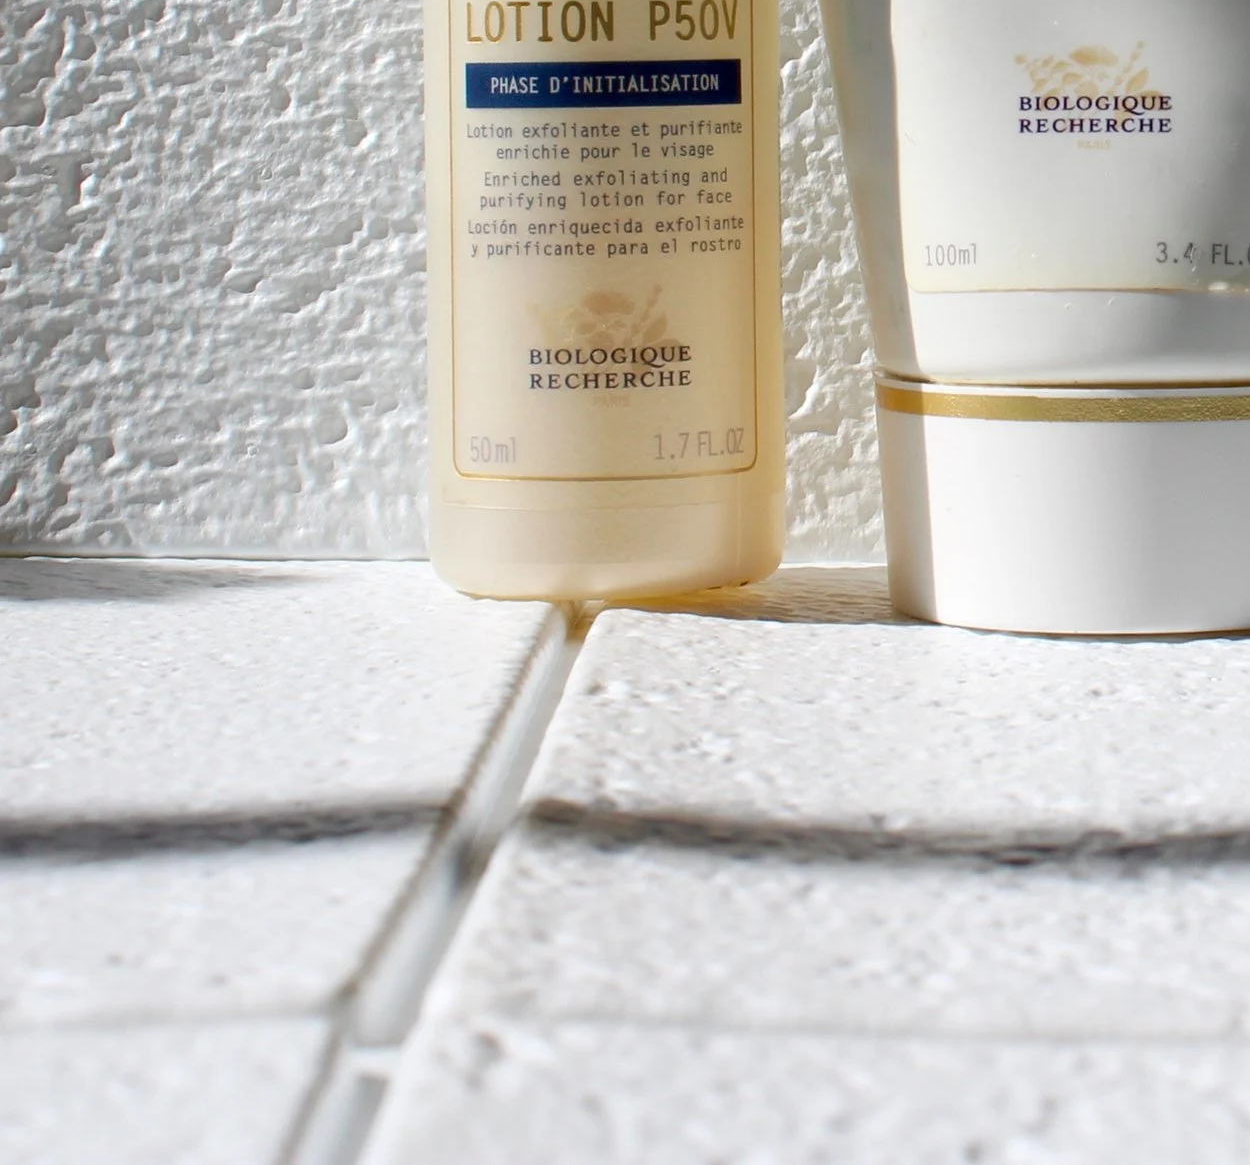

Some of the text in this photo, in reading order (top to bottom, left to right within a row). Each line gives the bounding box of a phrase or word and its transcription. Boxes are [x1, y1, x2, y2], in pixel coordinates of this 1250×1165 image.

[467, 0, 737, 42] LOTION P50V
[490, 74, 719, 94] PHASE D'INITIALISATION
[1020, 96, 1172, 115] BIOLOGIQUE
[467, 120, 742, 140] Lotion exfoliante et purifiante
[1019, 118, 1171, 133] RECHERCHE
[497, 142, 714, 162] enrichie pour le visage
[485, 168, 727, 186] Enriched exfoliating and
[480, 189, 732, 210] purifying lotion for face
[468, 216, 744, 238] Loción enriquecida exfoliante
[471, 238, 741, 258] y purificante para el rostro
[925, 243, 977, 267] 100ml
[530, 346, 691, 368] BIOLOGIQUE
[530, 370, 691, 389] RECHERCHE
[655, 428, 745, 460] 1.7 FL.OZ
